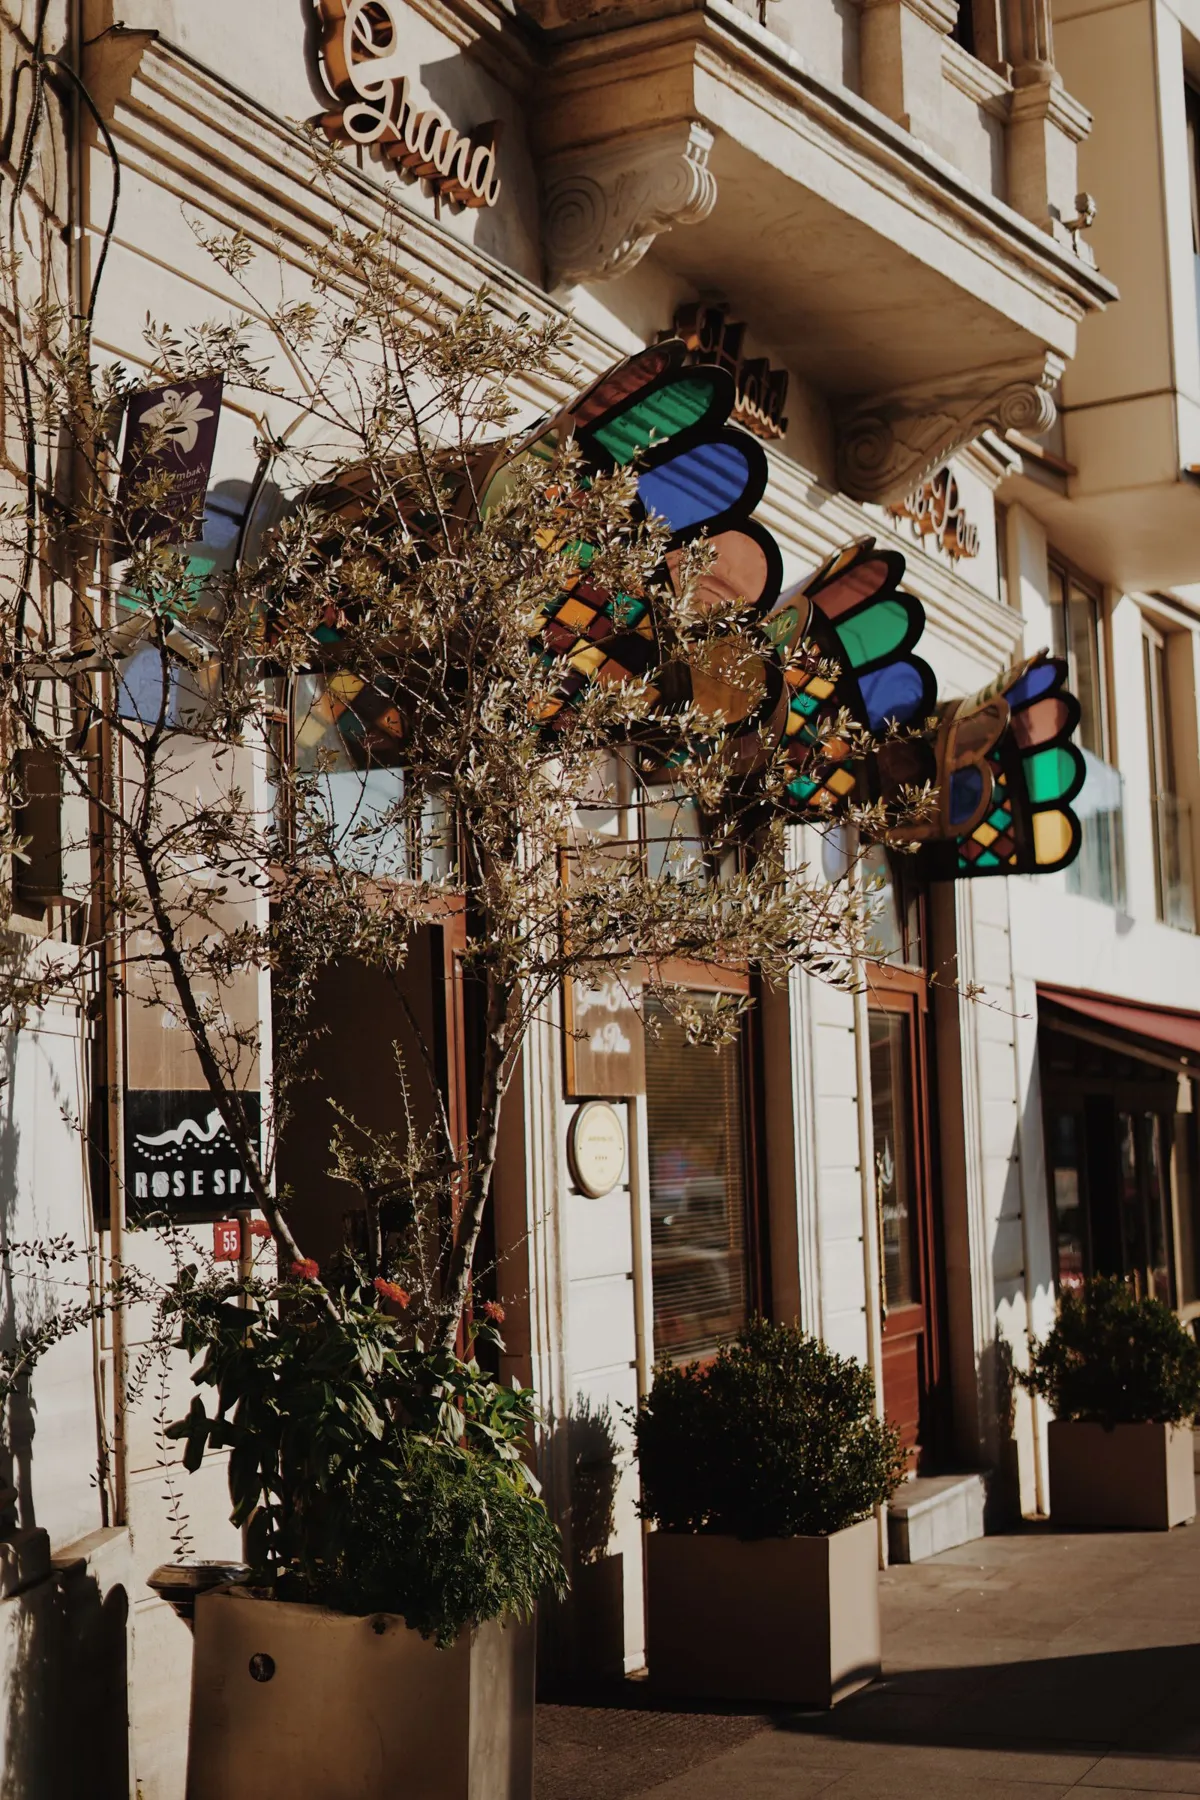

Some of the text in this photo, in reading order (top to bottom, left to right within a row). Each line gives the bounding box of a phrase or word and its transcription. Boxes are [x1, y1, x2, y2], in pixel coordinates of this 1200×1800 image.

[342, 0, 501, 207] Grand
[135, 1170, 204, 1198] ROSE
[223, 1231, 237, 1252] 55
